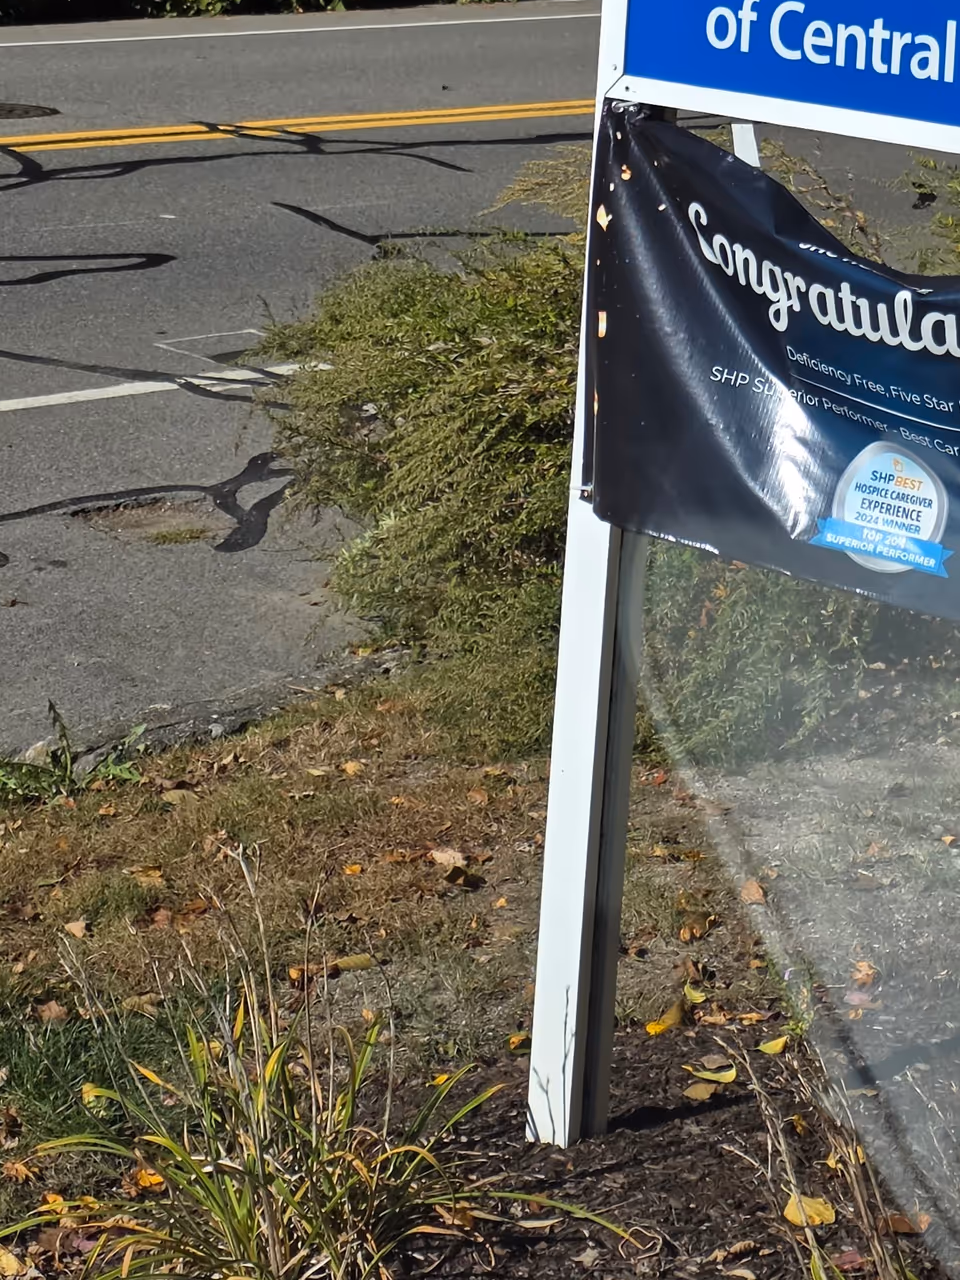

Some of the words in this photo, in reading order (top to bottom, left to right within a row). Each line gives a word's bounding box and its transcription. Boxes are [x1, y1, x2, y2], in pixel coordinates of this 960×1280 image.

[769, 0, 957, 83] Central
[786, 345, 851, 384] Deficiency
[853, 373, 889, 399] Free,
[890, 385, 921, 405] Five
[923, 394, 954, 413] Star
[710, 366, 750, 388] SHP
[752, 378, 819, 407] Suerior
[822, 397, 889, 432] Performer
[899, 427, 933, 449] Best
[854, 482, 889, 499] HOSPICE
[890, 491, 933, 509] CAREGIVER
[860, 498, 922, 522] EXPERIENCE
[854, 511, 880, 526] 2024
[881, 517, 921, 535] WINNER
[862, 528, 885, 543] TOP
[825, 533, 874, 553] SUPERIOR
[876, 545, 936, 568] PERFORMER
